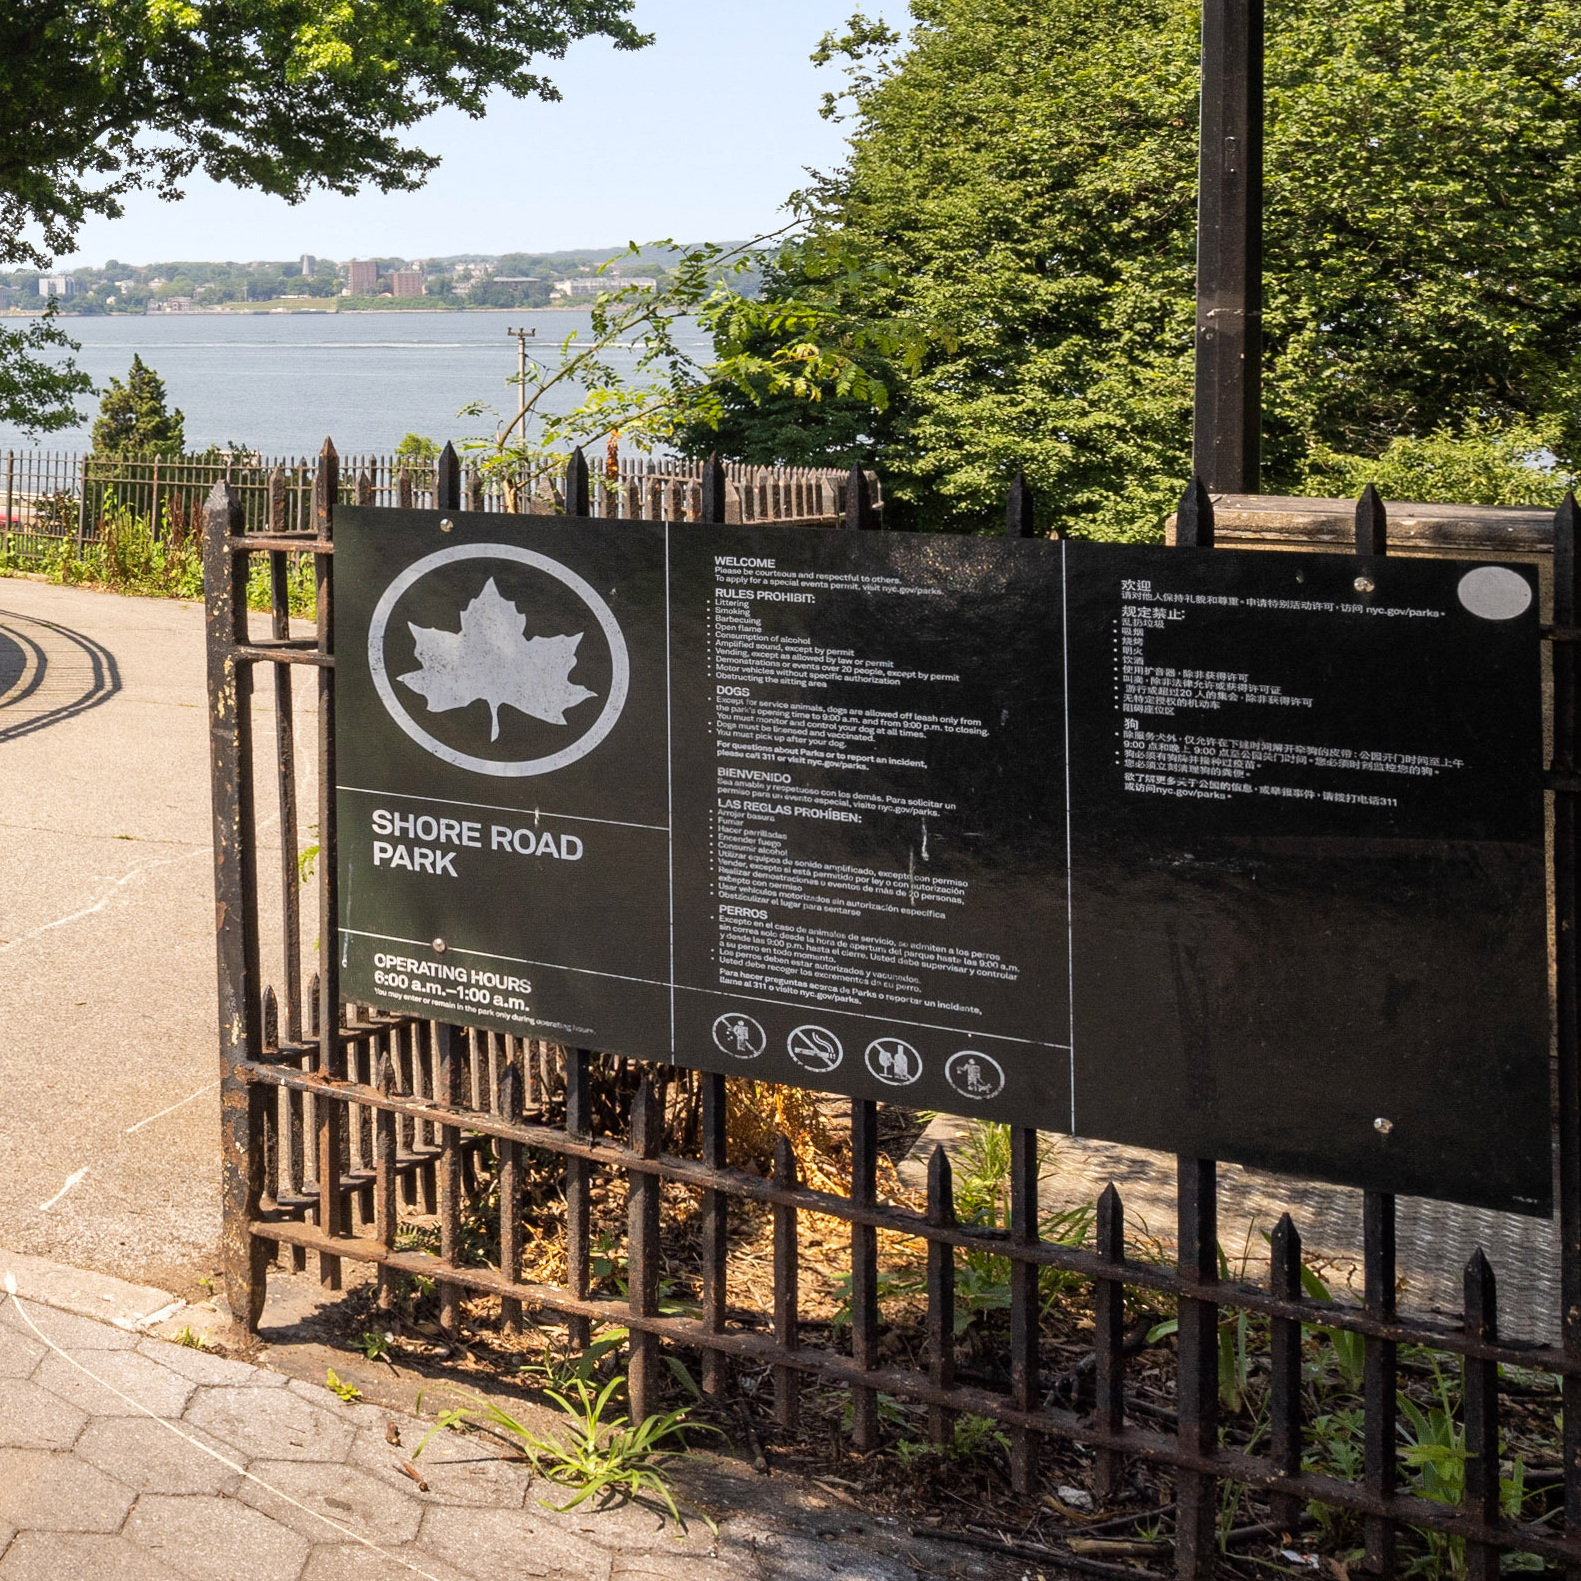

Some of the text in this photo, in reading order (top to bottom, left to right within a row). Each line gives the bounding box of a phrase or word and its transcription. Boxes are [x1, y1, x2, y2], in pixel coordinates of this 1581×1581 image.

[714, 555, 775, 568] WELCOME
[714, 566, 741, 574] Please
[755, 570, 797, 578] courteous
[815, 573, 859, 581] respectful
[725, 576, 748, 584] apply
[749, 576, 761, 584] for
[1121, 578, 1151, 593] 欢迎
[715, 587, 815, 603] RULES PROHIBIT:
[715, 598, 749, 609] Littering
[715, 606, 750, 617] Smoking
[715, 614, 761, 625] Barbecuing
[715, 622, 762, 633] Open flame
[1121, 627, 1143, 636] 吸烟
[715, 631, 769, 641] Consumption
[780, 636, 811, 644] alcohol
[1121, 636, 1143, 646] 烧烤
[715, 639, 754, 648] Amplified
[814, 646, 825, 655] by
[826, 648, 854, 656] permit
[1122, 646, 1142, 655] 明火
[792, 654, 824, 662] allowed
[826, 655, 836, 664] by
[865, 660, 894, 668] permit
[1122, 655, 1143, 665] 饮酒
[715, 655, 780, 666] Demonstrations
[886, 670, 916, 678] except
[917, 671, 929, 680] by
[930, 673, 960, 682] permit
[715, 663, 739, 671] Motor
[843, 675, 900, 685] authorization
[715, 671, 764, 683] Obstructing
[780, 677, 807, 687] sitting
[808, 680, 827, 688] area
[716, 685, 750, 697] DOGS
[757, 709, 790, 718] opening
[880, 718, 901, 727] from
[903, 721, 922, 729] 9:00
[827, 705, 848, 715] dogs
[864, 709, 898, 718] allowed
[914, 713, 938, 722] leash
[939, 716, 959, 725] only
[959, 716, 981, 726] from
[858, 726, 875, 734] dog
[886, 728, 898, 736] all
[1123, 717, 1139, 730] 狗
[755, 732, 772, 740] pick
[786, 735, 807, 743] after
[716, 740, 730, 748] For
[773, 746, 798, 755] about
[800, 748, 824, 757] Parks
[847, 754, 875, 763] report
[1123, 740, 1144, 748] 9:00
[1194, 746, 1215, 755] 9:00
[761, 752, 775, 760] 311
[787, 756, 806, 764] visit
[717, 766, 791, 783] BIENVENIDO
[717, 798, 862, 823] LAS REGLAS PROHÍBEN:
[371, 809, 583, 860] SHORE ROAD
[373, 840, 458, 877] PARK
[719, 904, 768, 920] PERROS
[374, 953, 532, 993] OPERATING HOURS
[374, 970, 408, 988] 6:00
[493, 994, 530, 1011] a.m.
[388, 991, 402, 1000] may
[403, 994, 422, 1002] enter
[431, 999, 456, 1009] remain
[464, 1005, 477, 1013] the
[477, 1008, 494, 1016] park
[495, 1011, 511, 1020] only
[511, 1013, 535, 1025] during
